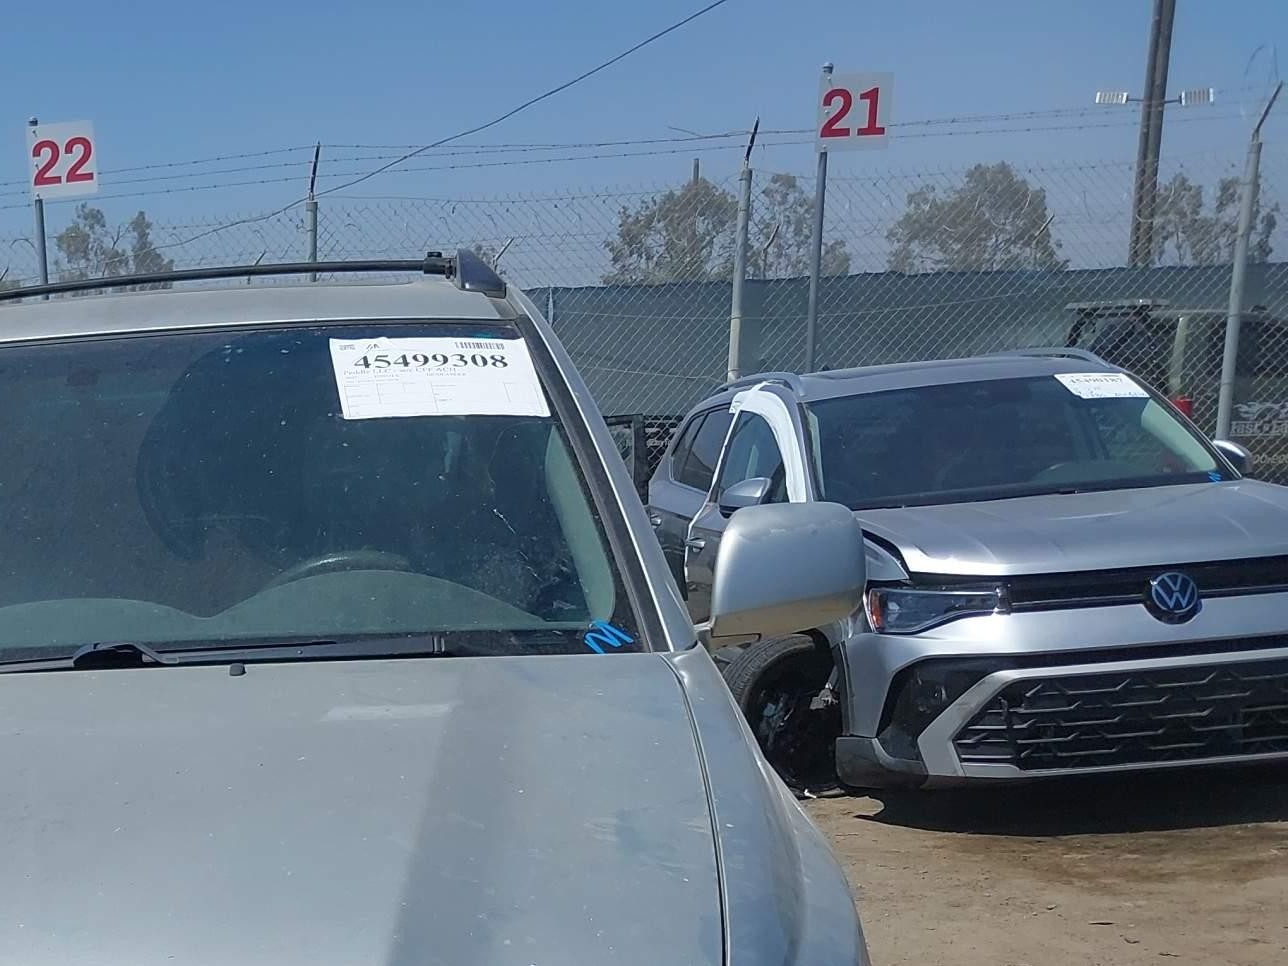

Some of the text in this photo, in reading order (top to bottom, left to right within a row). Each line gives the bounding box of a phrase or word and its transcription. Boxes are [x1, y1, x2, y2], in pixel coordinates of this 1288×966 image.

[820, 87, 885, 138] 21
[32, 136, 94, 186] 22
[353, 353, 508, 369] 45499308
